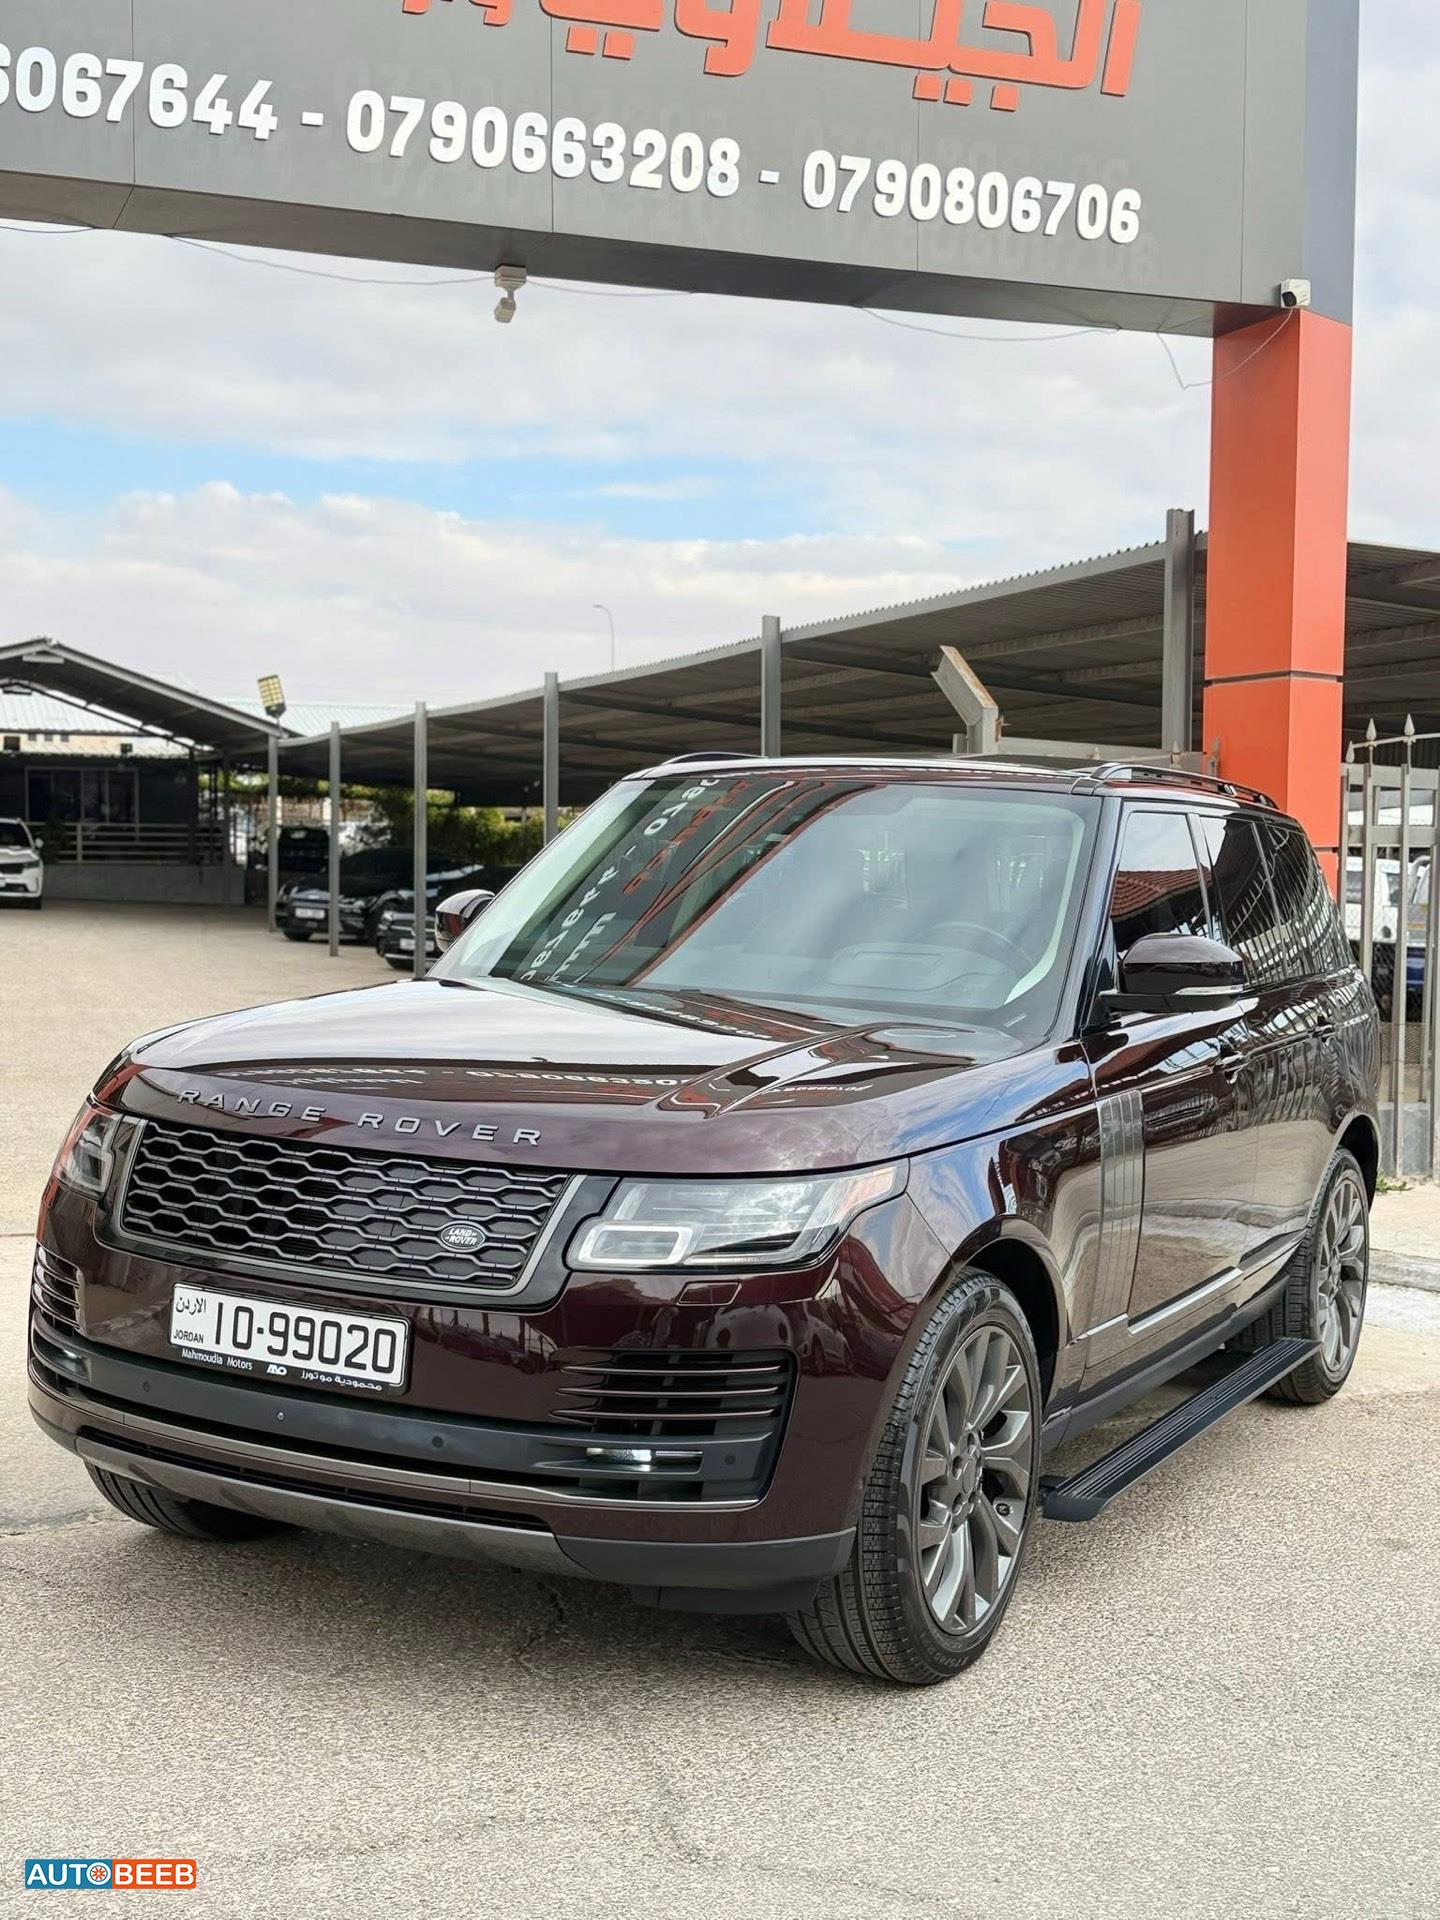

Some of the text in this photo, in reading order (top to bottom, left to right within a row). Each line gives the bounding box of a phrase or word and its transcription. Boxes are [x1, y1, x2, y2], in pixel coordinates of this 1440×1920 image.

[0, 41, 278, 141] 067644
[346, 90, 740, 197] 0790663208
[802, 150, 1142, 244] 0790806706
[177, 1089, 542, 1147] RANGE ROVER
[173, 1329, 205, 1344] JORDAN
[181, 1348, 253, 1371] Mahmoudia Motors
[214, 1301, 397, 1374] 10-99020
